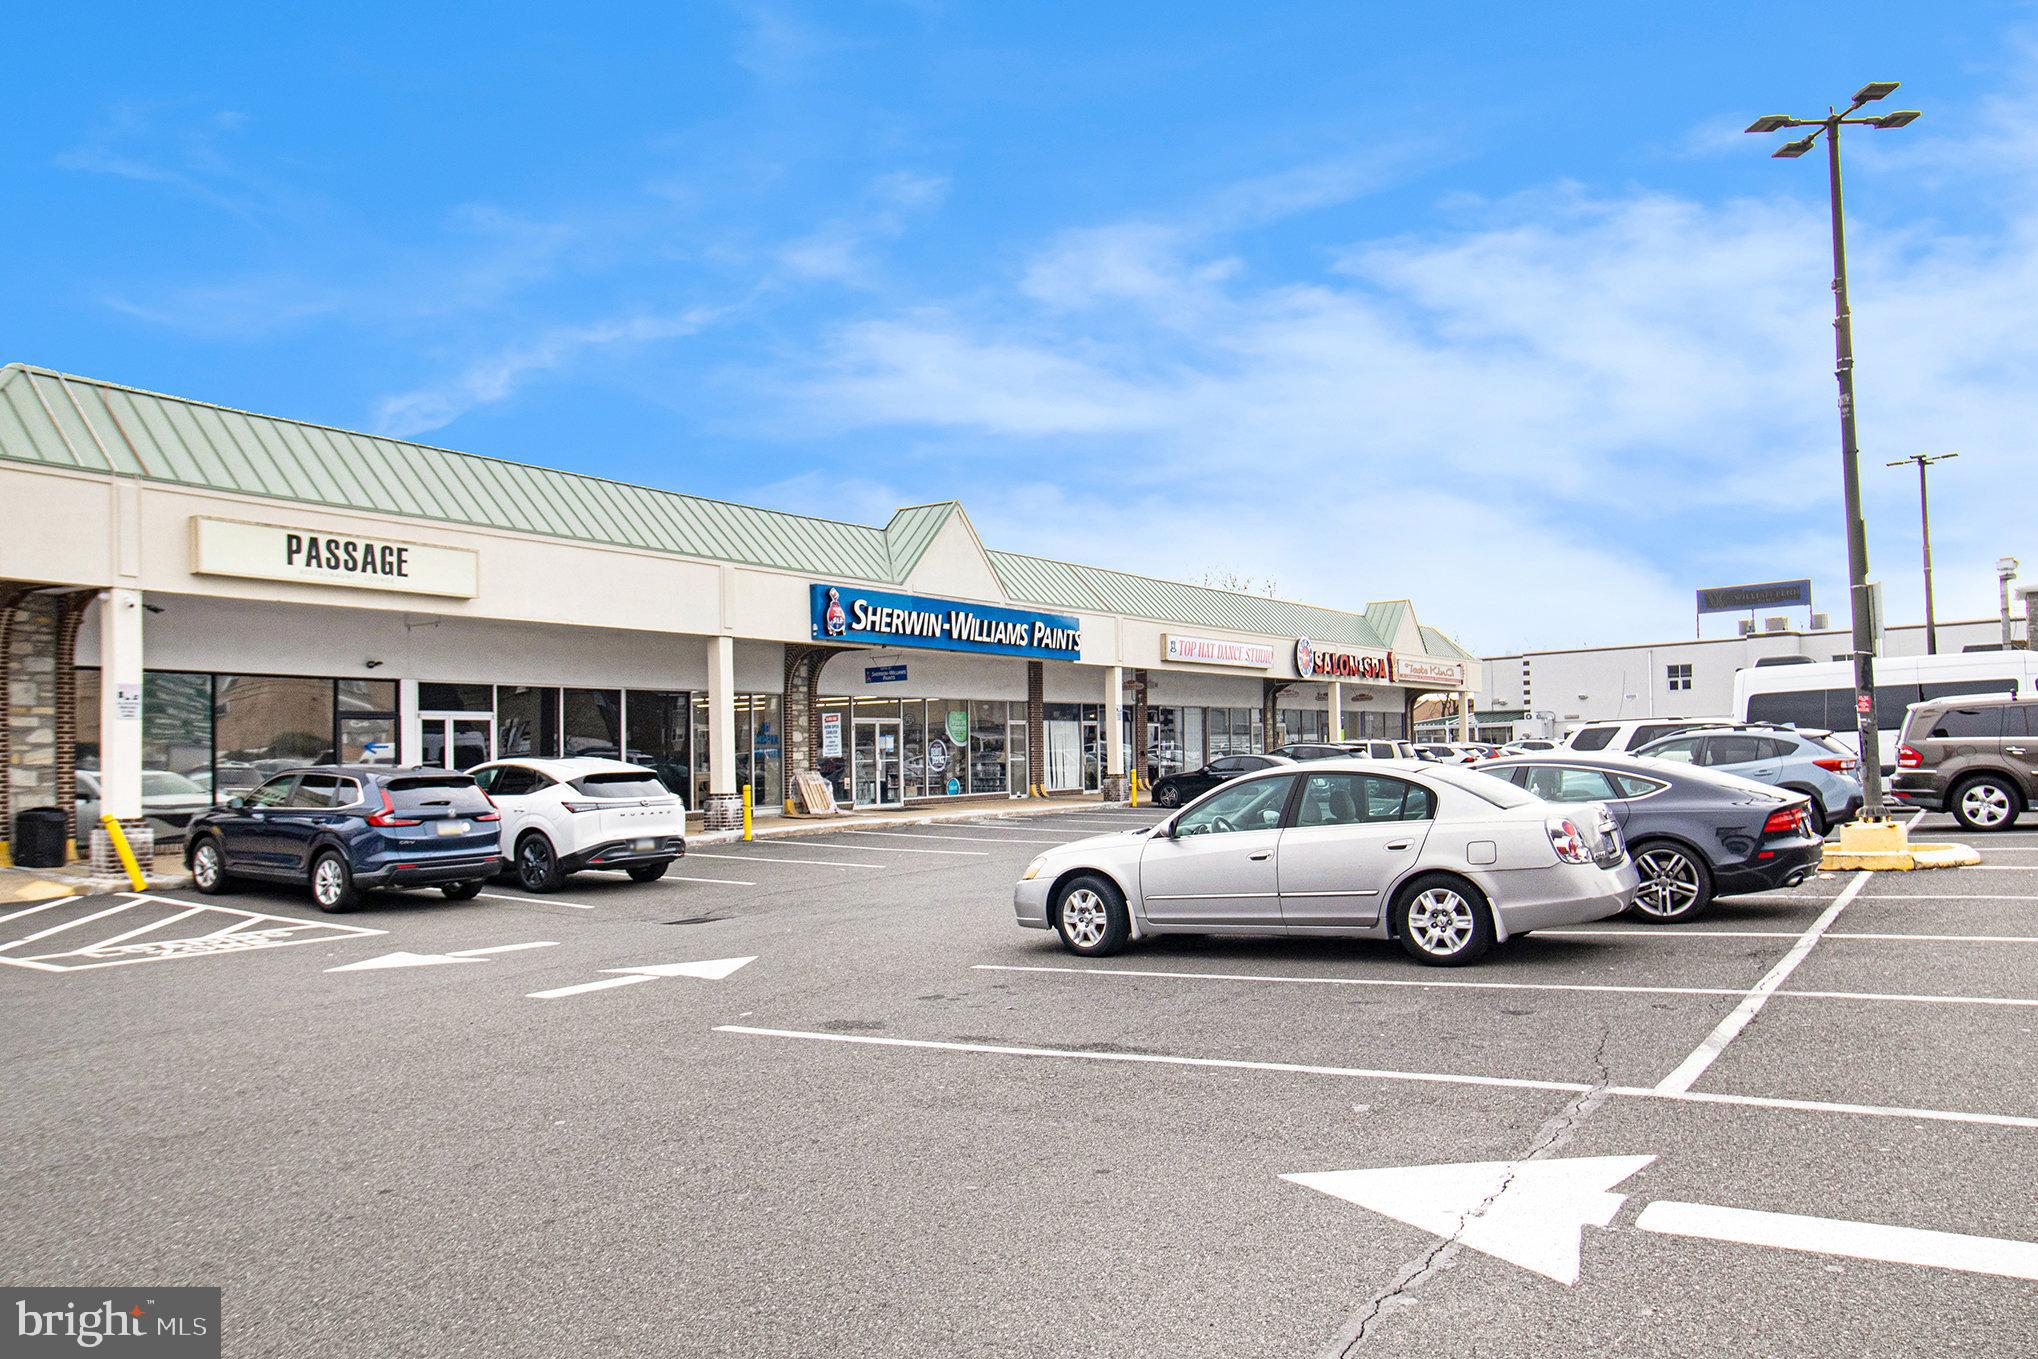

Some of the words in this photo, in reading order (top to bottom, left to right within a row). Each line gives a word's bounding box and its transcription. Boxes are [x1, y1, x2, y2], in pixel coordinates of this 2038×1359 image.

[287, 533, 408, 577] PASSAGE
[852, 598, 1029, 647] SHERWIN-WILLIAMS
[1033, 620, 1082, 651] PAINTS
[1179, 640, 1197, 657] TOP
[1198, 642, 1216, 659] HAT
[1217, 644, 1245, 662] DANCE
[1314, 650, 1359, 678] SALON
[1363, 656, 1388, 679] SPA
